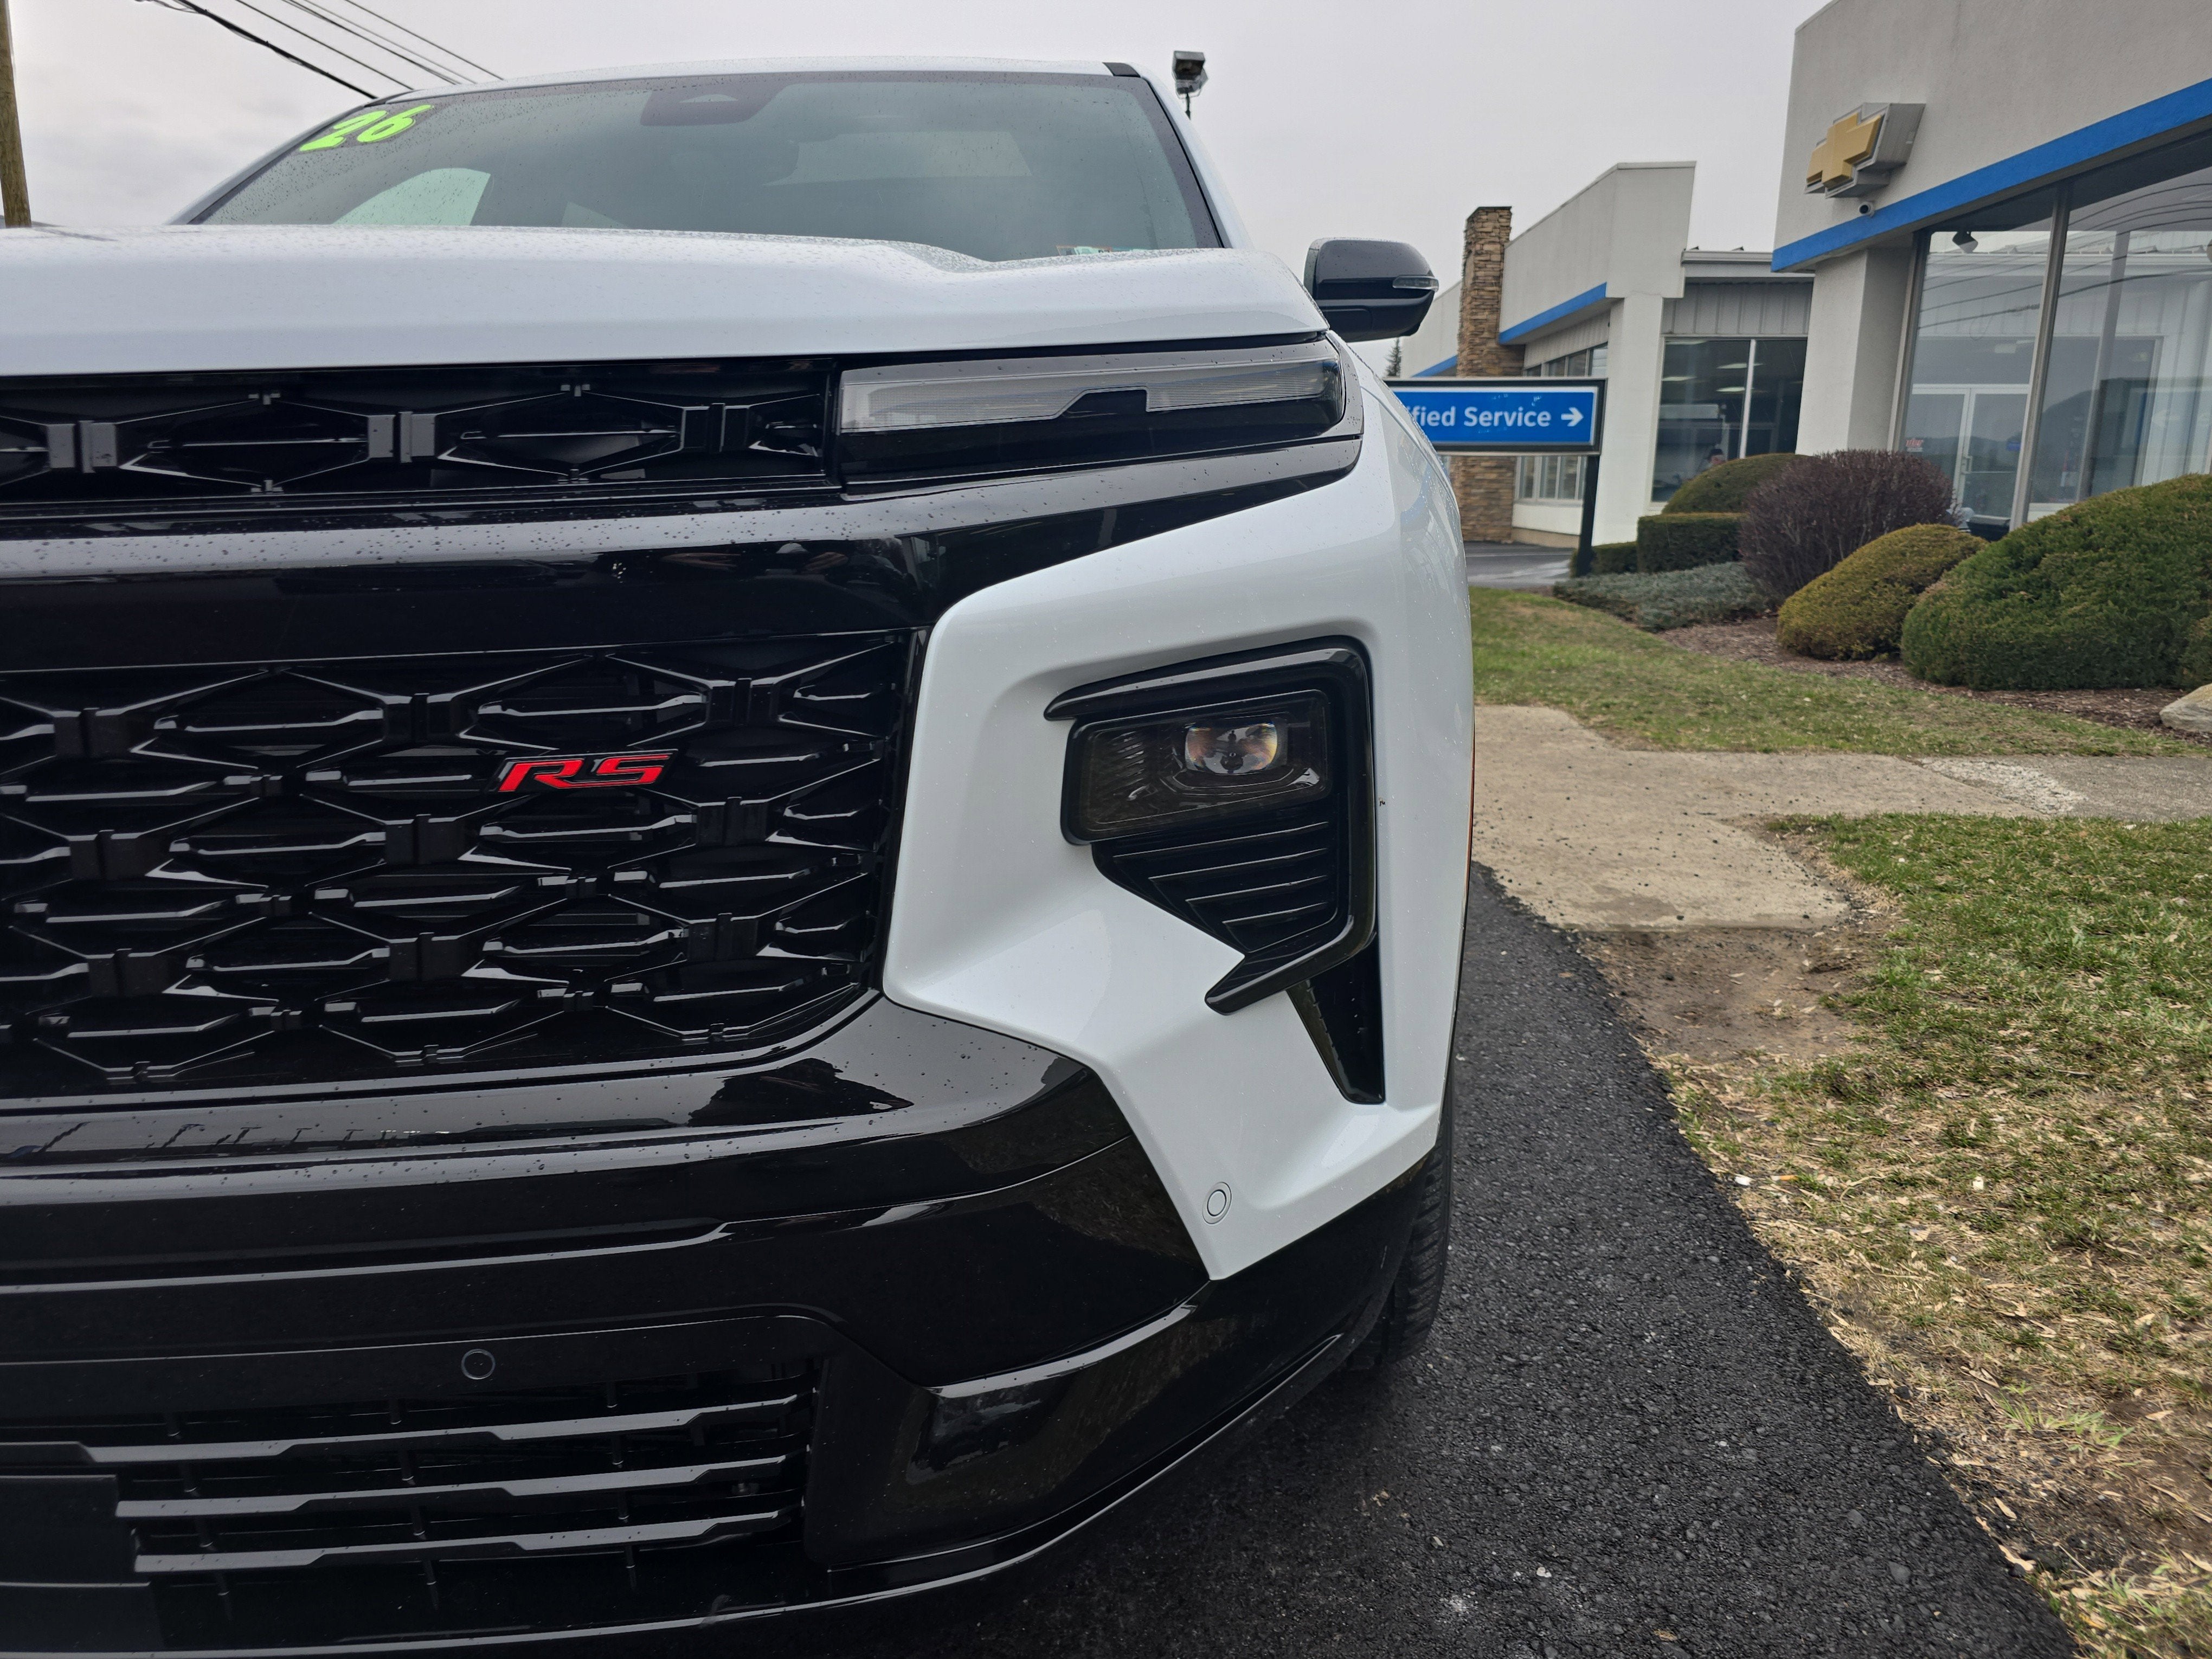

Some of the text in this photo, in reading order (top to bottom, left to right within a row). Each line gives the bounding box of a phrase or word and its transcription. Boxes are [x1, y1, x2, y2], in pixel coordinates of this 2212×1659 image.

[299, 104, 433, 151] 26
[1407, 406, 1552, 427] fied Service
[498, 754, 671, 793] RS
